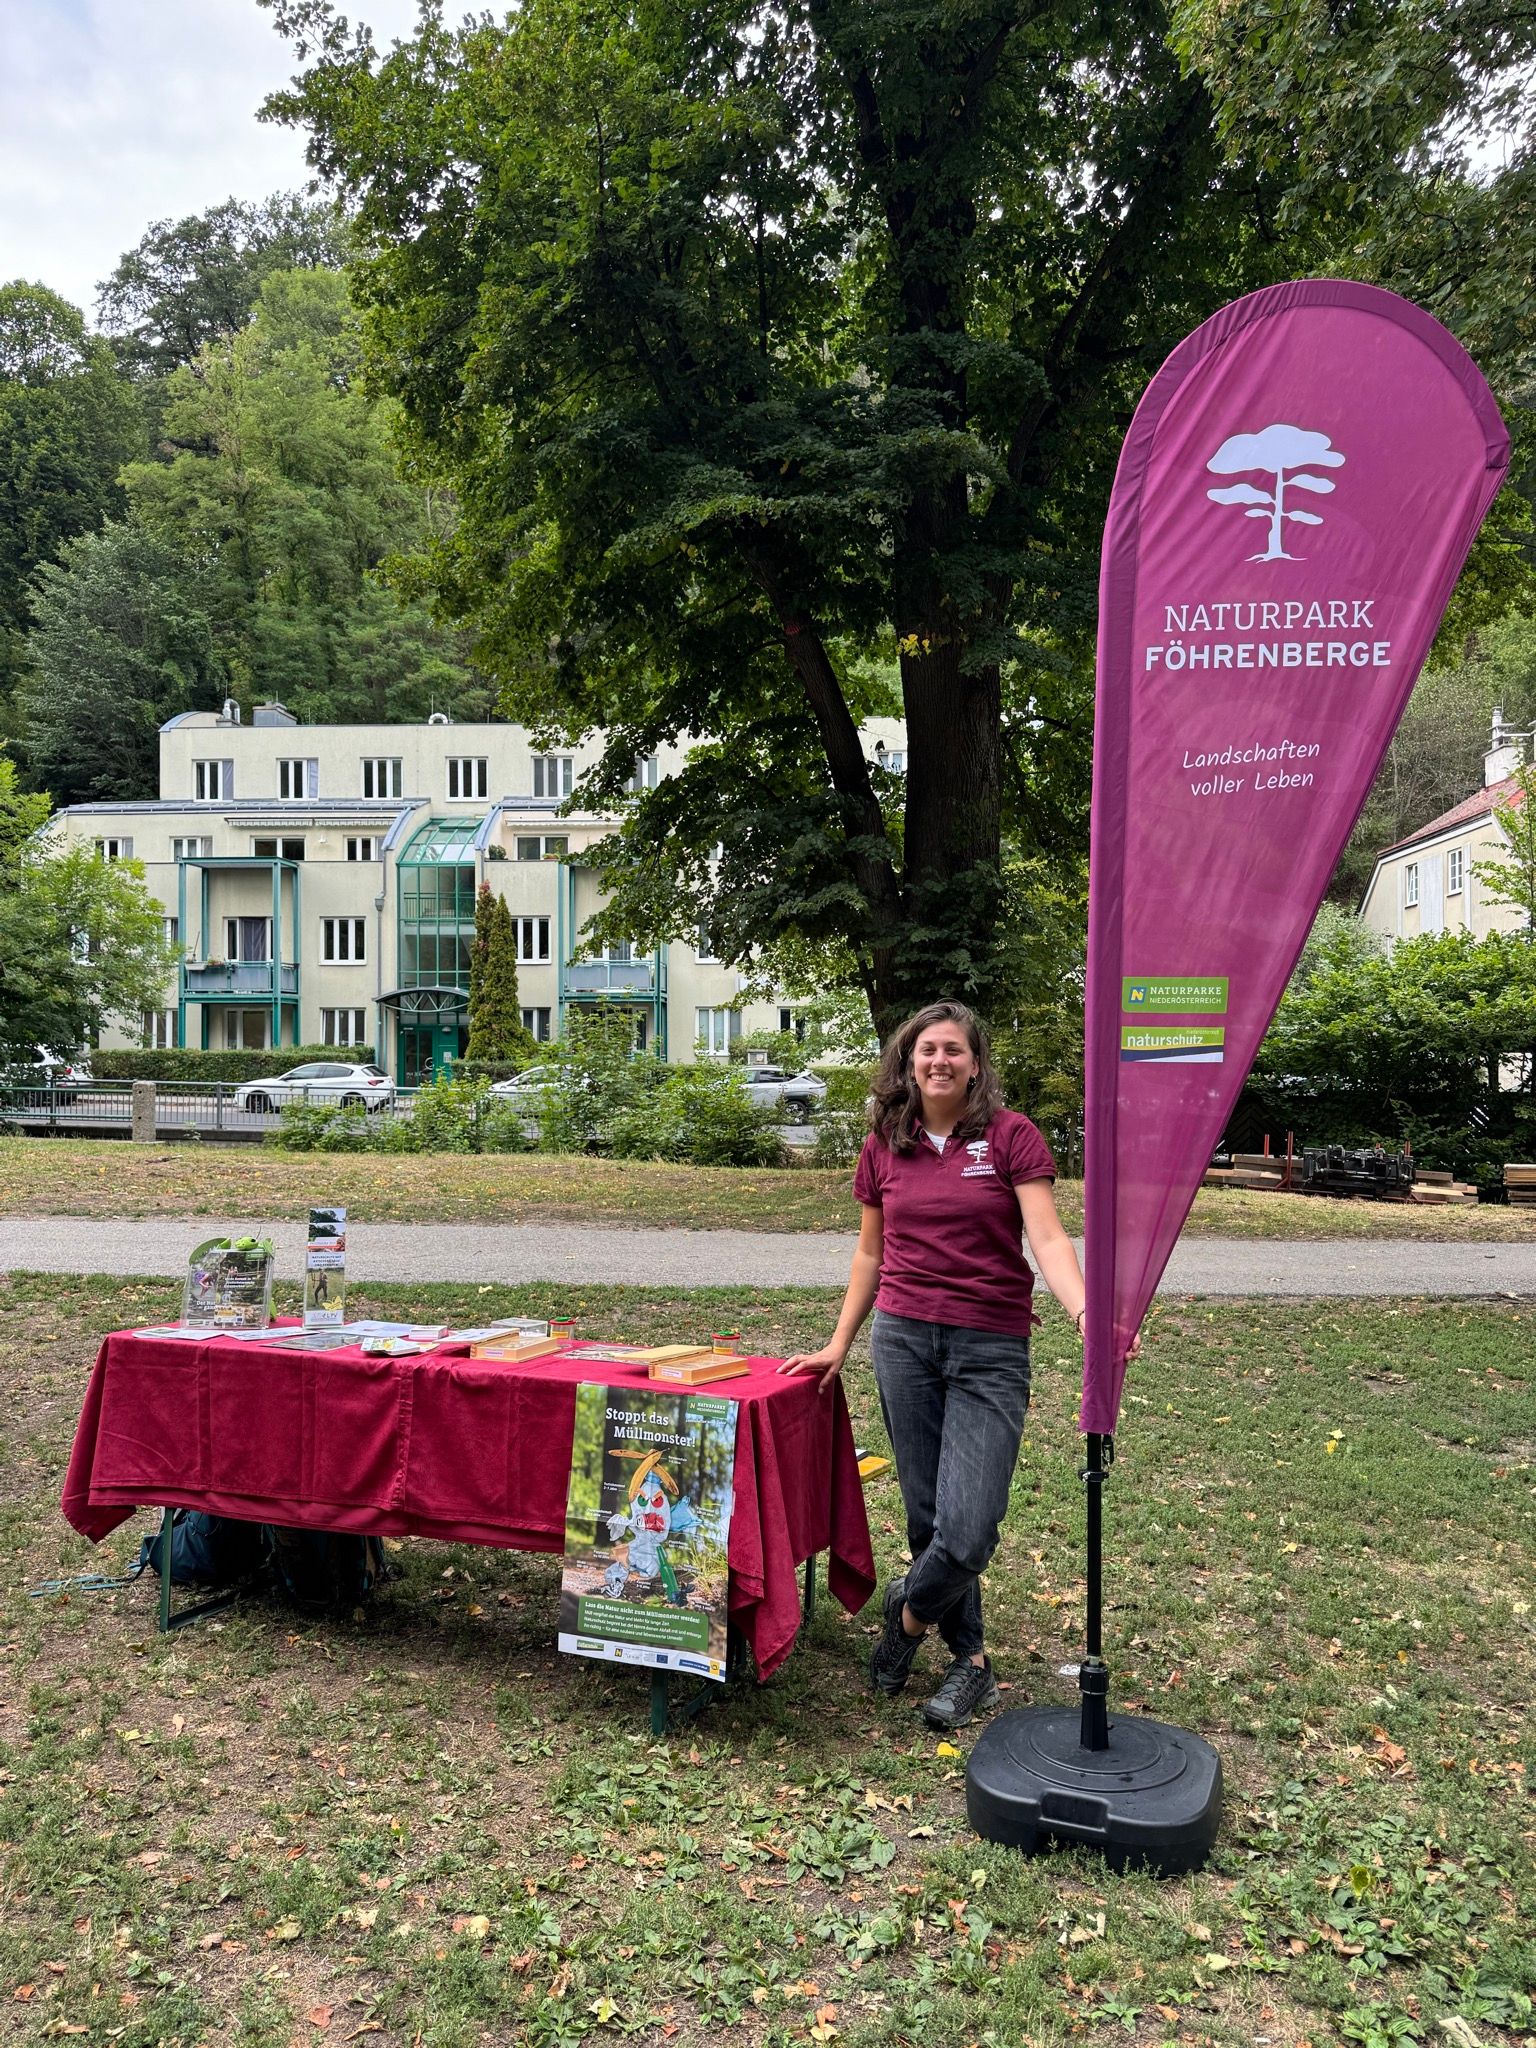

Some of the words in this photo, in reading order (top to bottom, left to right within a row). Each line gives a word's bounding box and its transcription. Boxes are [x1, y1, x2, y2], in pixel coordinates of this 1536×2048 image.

[1163, 600, 1375, 633] NATURPARK
[1145, 639, 1392, 671] FÖHRENBERGE
[1183, 739, 1321, 769] Landschaften
[1191, 776, 1245, 797] voller
[1254, 769, 1314, 791] Leben
[1150, 986, 1222, 995] NATURPARKE
[1127, 1033, 1204, 1047] naturschutz
[605, 1407, 647, 1426] Stoppt
[649, 1411, 669, 1426] das
[613, 1426, 696, 1448] Müllmonster!
[585, 1601, 596, 1609] Lass
[605, 1604, 620, 1612] Natur
[620, 1606, 634, 1614] nicht
